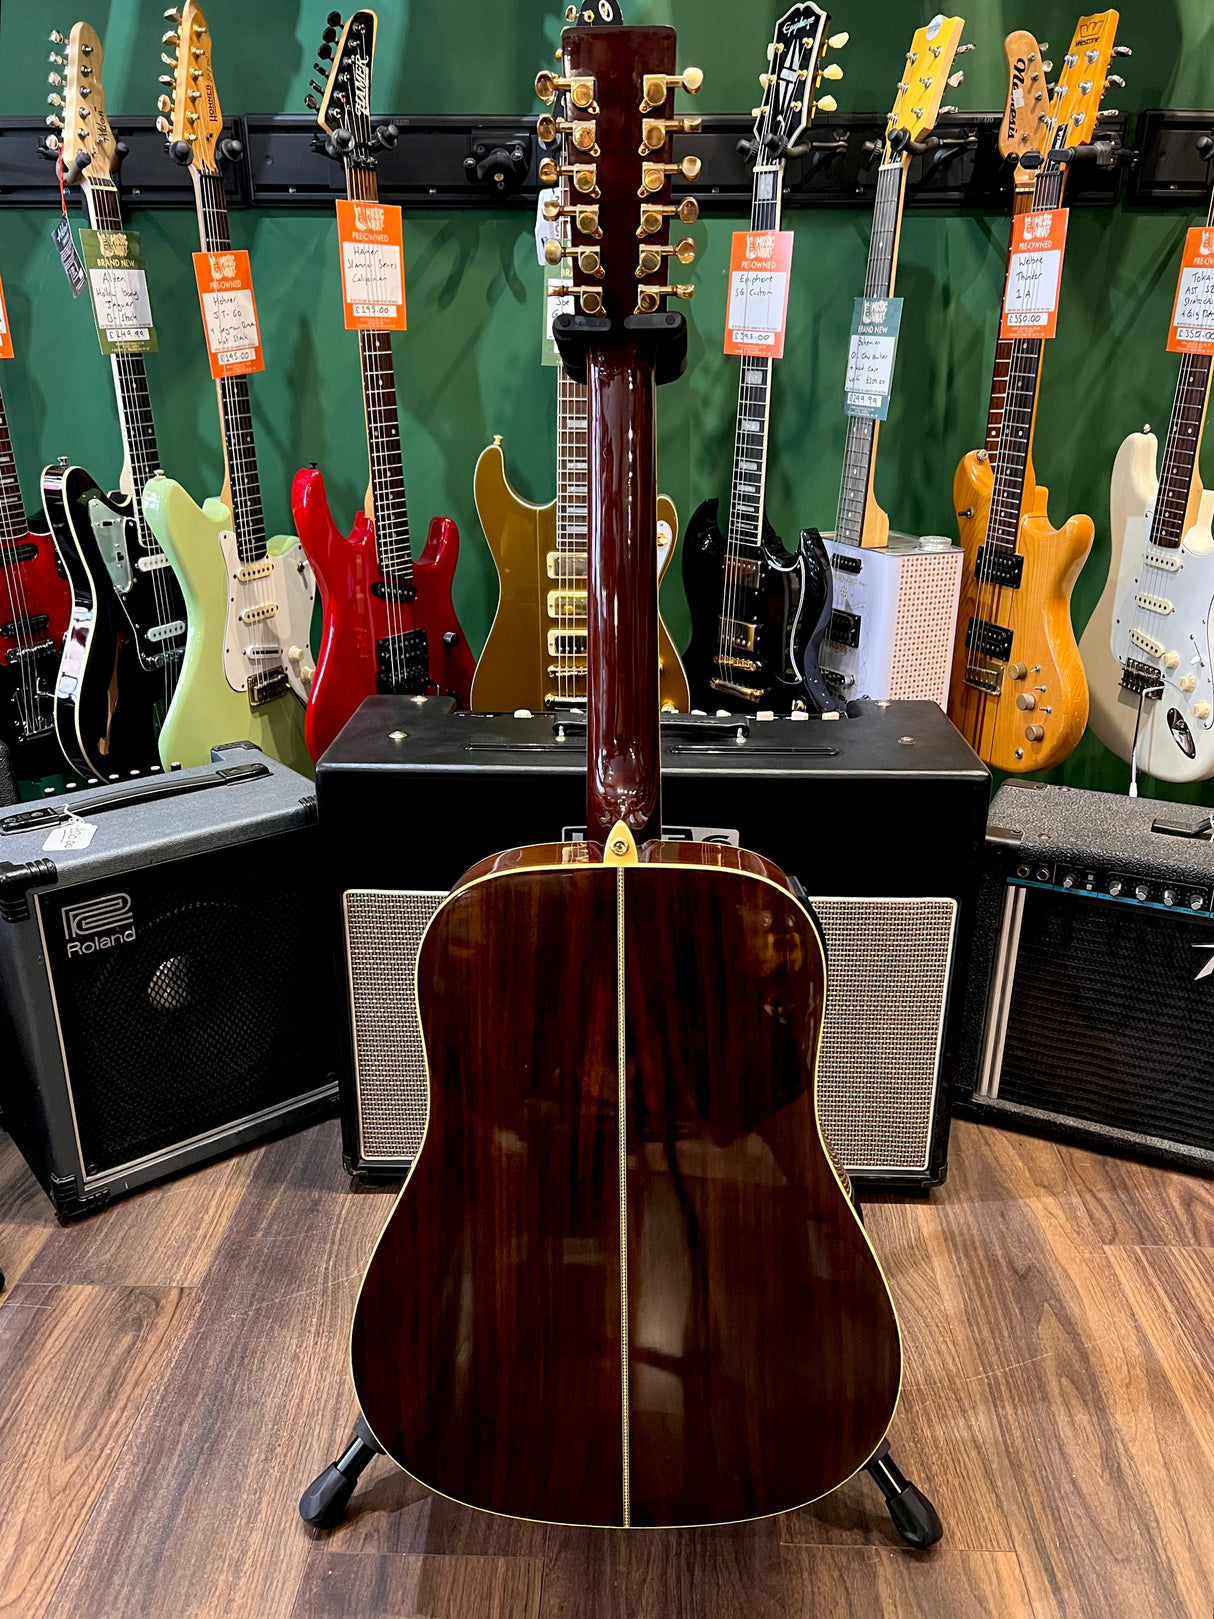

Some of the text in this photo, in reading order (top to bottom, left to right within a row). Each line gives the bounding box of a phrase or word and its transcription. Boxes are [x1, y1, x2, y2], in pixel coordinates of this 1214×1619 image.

[355, 54, 369, 116] HAMER
[1007, 58, 1026, 140] Neesis
[97, 258, 135, 267] BRAND NEW
[857, 325, 889, 335] BRAND NEW
[66, 925, 137, 959] Roland
